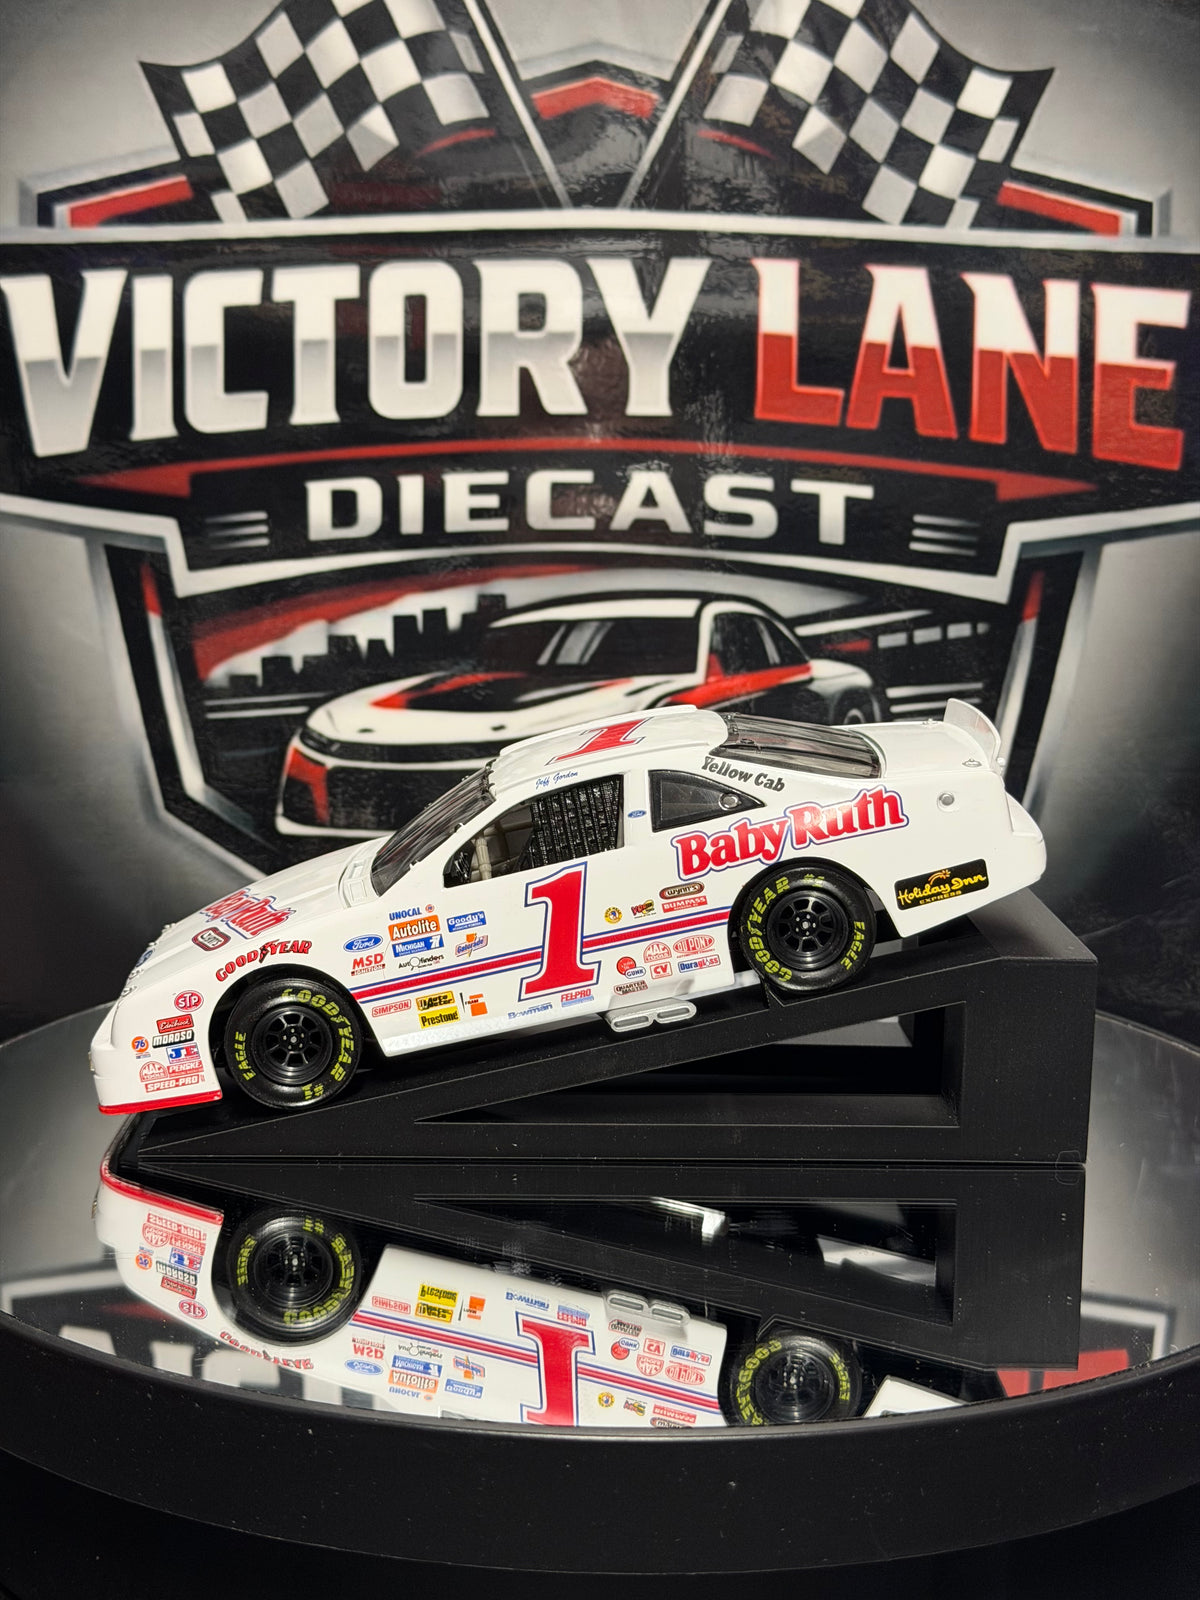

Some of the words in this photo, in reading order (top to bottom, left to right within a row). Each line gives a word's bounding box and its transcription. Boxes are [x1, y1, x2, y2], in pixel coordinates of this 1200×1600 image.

[0, 256, 712, 458] VICTORY
[751, 257, 1194, 471] LANE
[304, 469, 875, 543] DIECAST
[545, 717, 653, 766] 1
[535, 777, 551, 789] Jeff
[553, 771, 578, 784] Gordon
[701, 755, 753, 782] Yellow
[754, 772, 785, 792] Cab
[673, 819, 790, 880] Baby
[785, 787, 908, 849] Ruth
[898, 882, 950, 908] Holiday
[950, 873, 987, 891] Inn
[919, 891, 962, 904] EXPRESS
[664, 897, 706, 909] BUMPASS
[389, 907, 422, 921] UNOCAL
[392, 920, 438, 940] Autolite
[519, 862, 601, 1002] 1
[747, 876, 793, 982] GOODYEAR
[352, 938, 375, 951] Ford
[841, 921, 866, 970] EAGLE
[215, 939, 312, 982] GOODYEAR
[352, 952, 384, 969] MSD
[653, 963, 668, 975] CV
[626, 968, 644, 977] GUNK
[178, 993, 199, 1008] STP
[374, 1001, 410, 1016] SIMPSON
[421, 1011, 459, 1027] Prestone
[508, 1002, 553, 1019] Bowman
[135, 1039, 146, 1049] 76
[153, 1029, 193, 1047] MOROSO
[281, 988, 355, 1082] GOODYEAR
[169, 1045, 198, 1059] JE
[234, 1031, 257, 1081] EAGLE
[147, 1075, 198, 1092] SPEED-PRO
